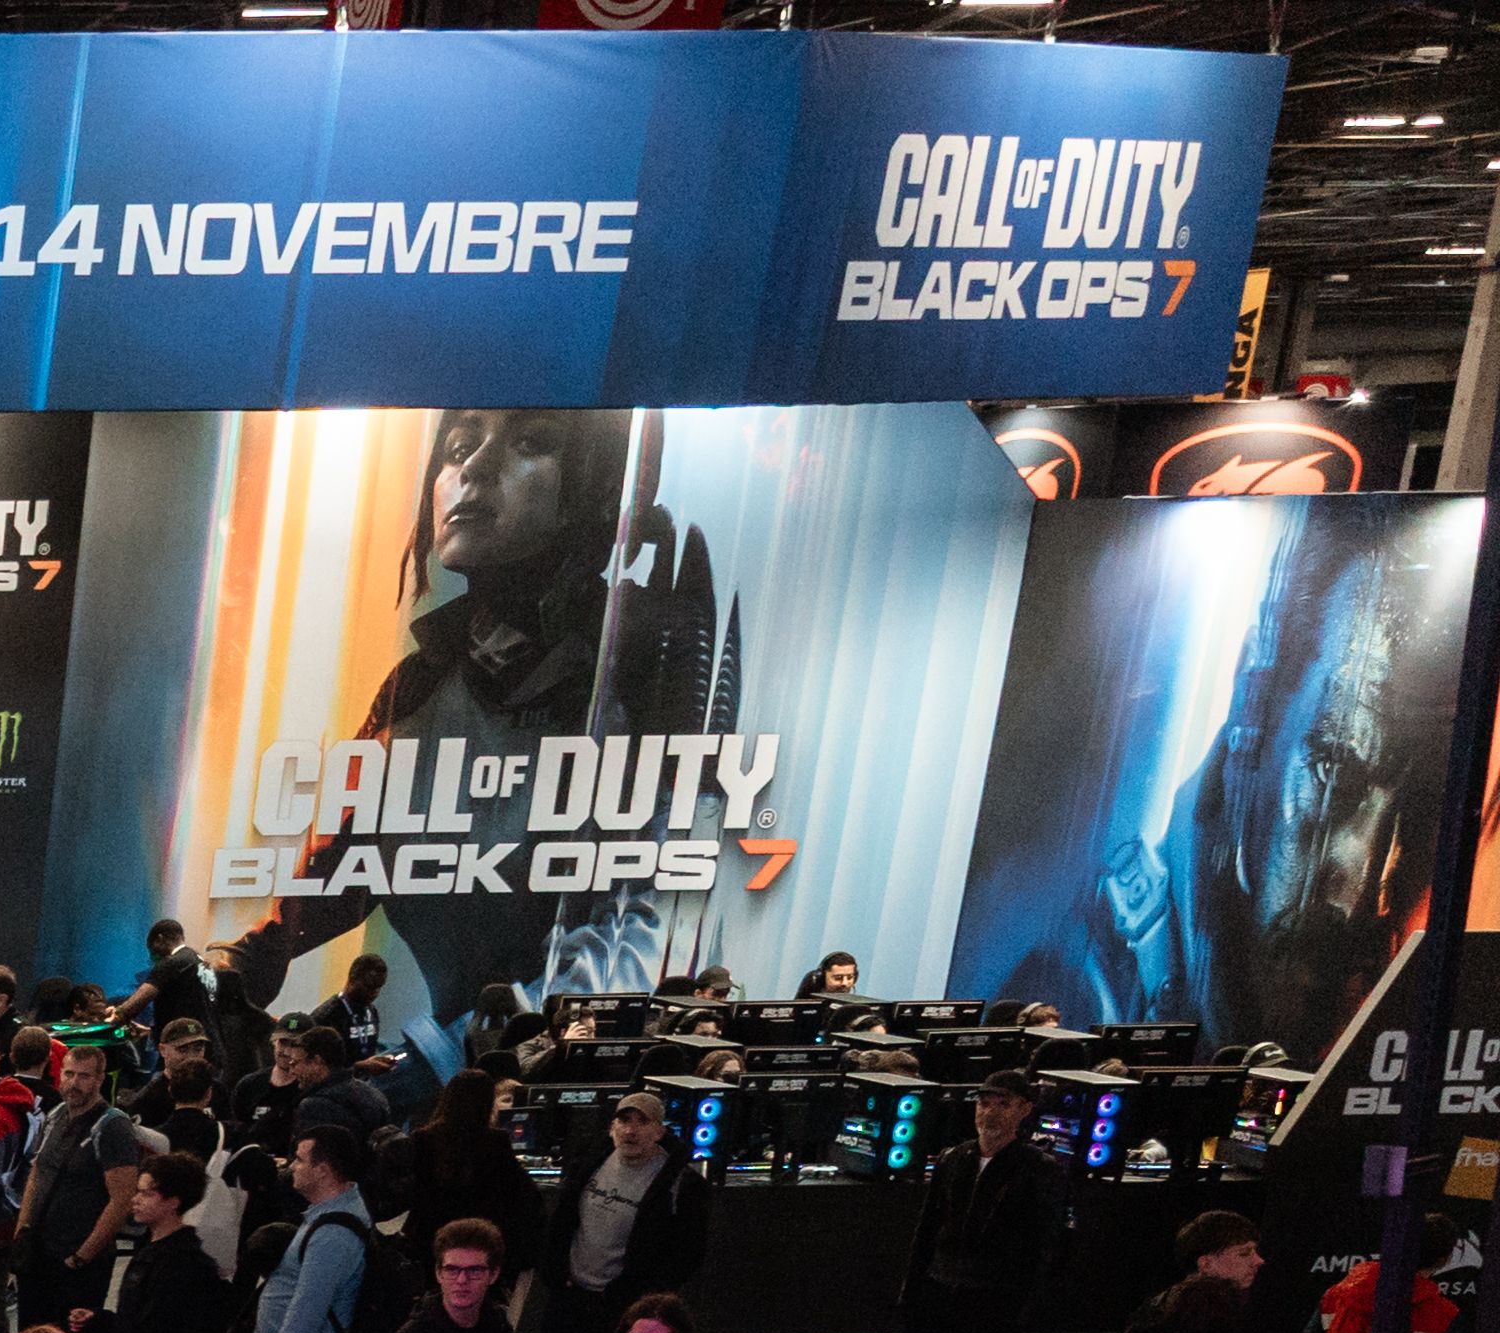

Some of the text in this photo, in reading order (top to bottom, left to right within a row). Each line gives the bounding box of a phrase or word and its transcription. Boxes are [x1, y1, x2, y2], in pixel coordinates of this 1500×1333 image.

[874, 134, 1202, 250] CALL OF DUTY
[117, 201, 639, 276] NOVEMBRE
[837, 260, 1197, 321] BLACK OPS 7
[1224, 306, 1260, 399] NGA
[28, 560, 61, 592] 7
[252, 733, 781, 836] CALL OF DUTY
[210, 839, 798, 899] BLACK OPS 7
[1370, 1030, 1486, 1082] CLL
[1343, 1085, 1500, 1117] BLCK
[1455, 1147, 1500, 1167] fna
